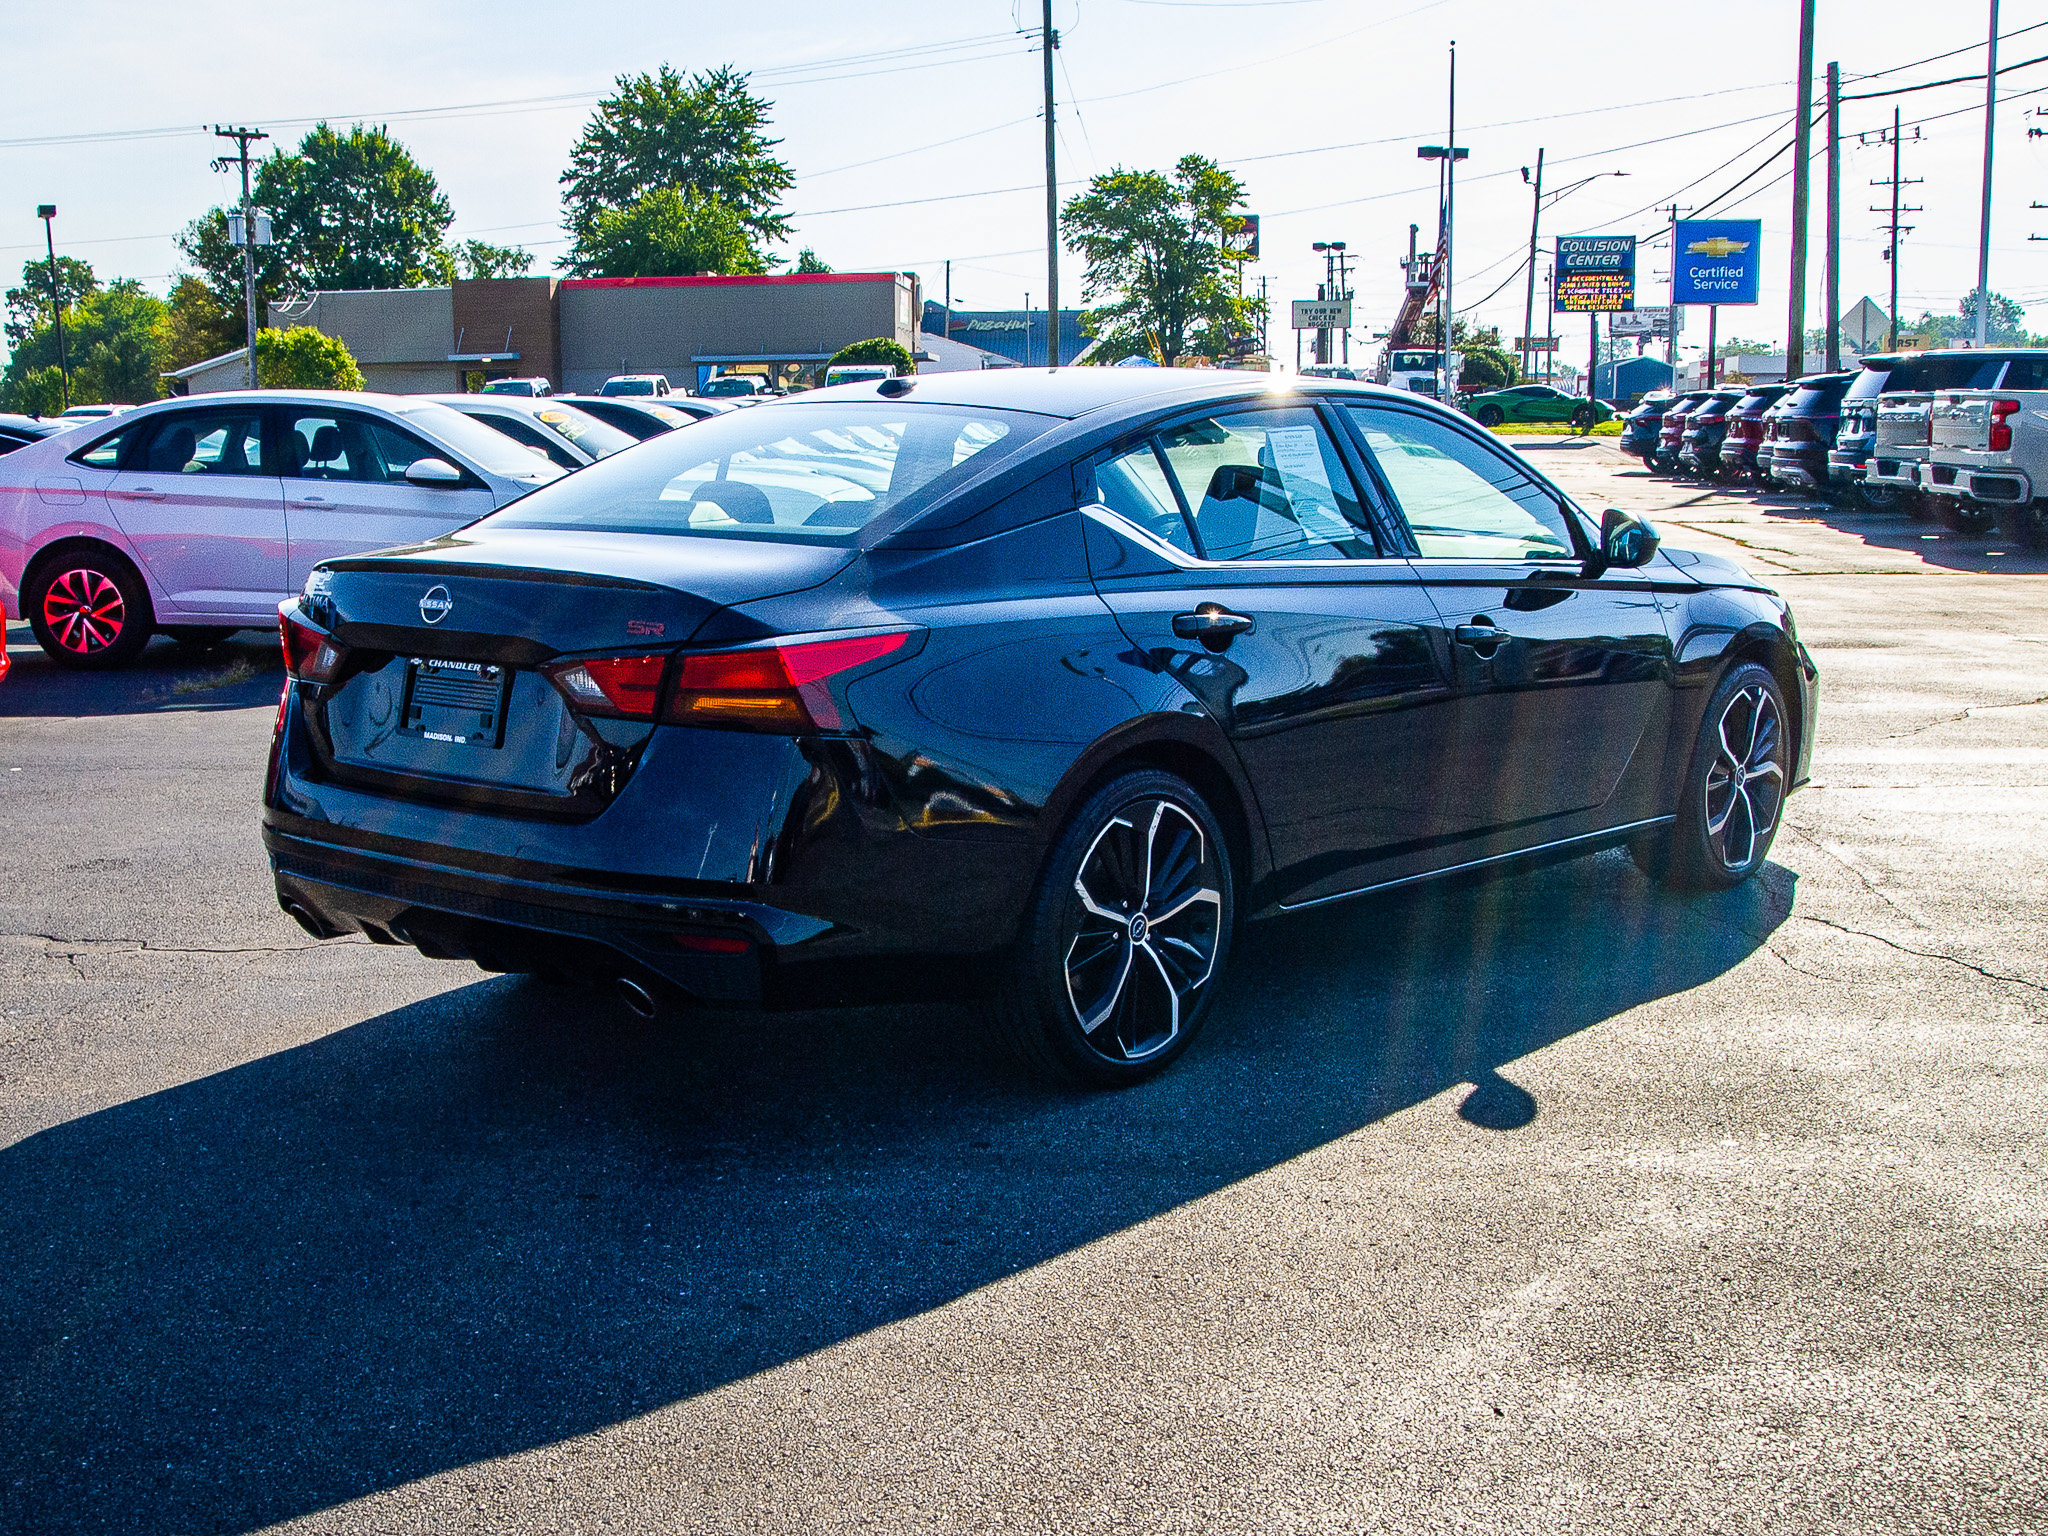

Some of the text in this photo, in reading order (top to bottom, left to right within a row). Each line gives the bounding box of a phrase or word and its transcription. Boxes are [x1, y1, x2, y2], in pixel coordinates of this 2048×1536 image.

[1559, 240, 1631, 252] COLLISION
[1566, 253, 1621, 266] CENTER
[1690, 266, 1744, 278] Certified
[1693, 278, 1739, 290] Service
[627, 620, 665, 637] SR
[428, 659, 481, 672] CHANDLER
